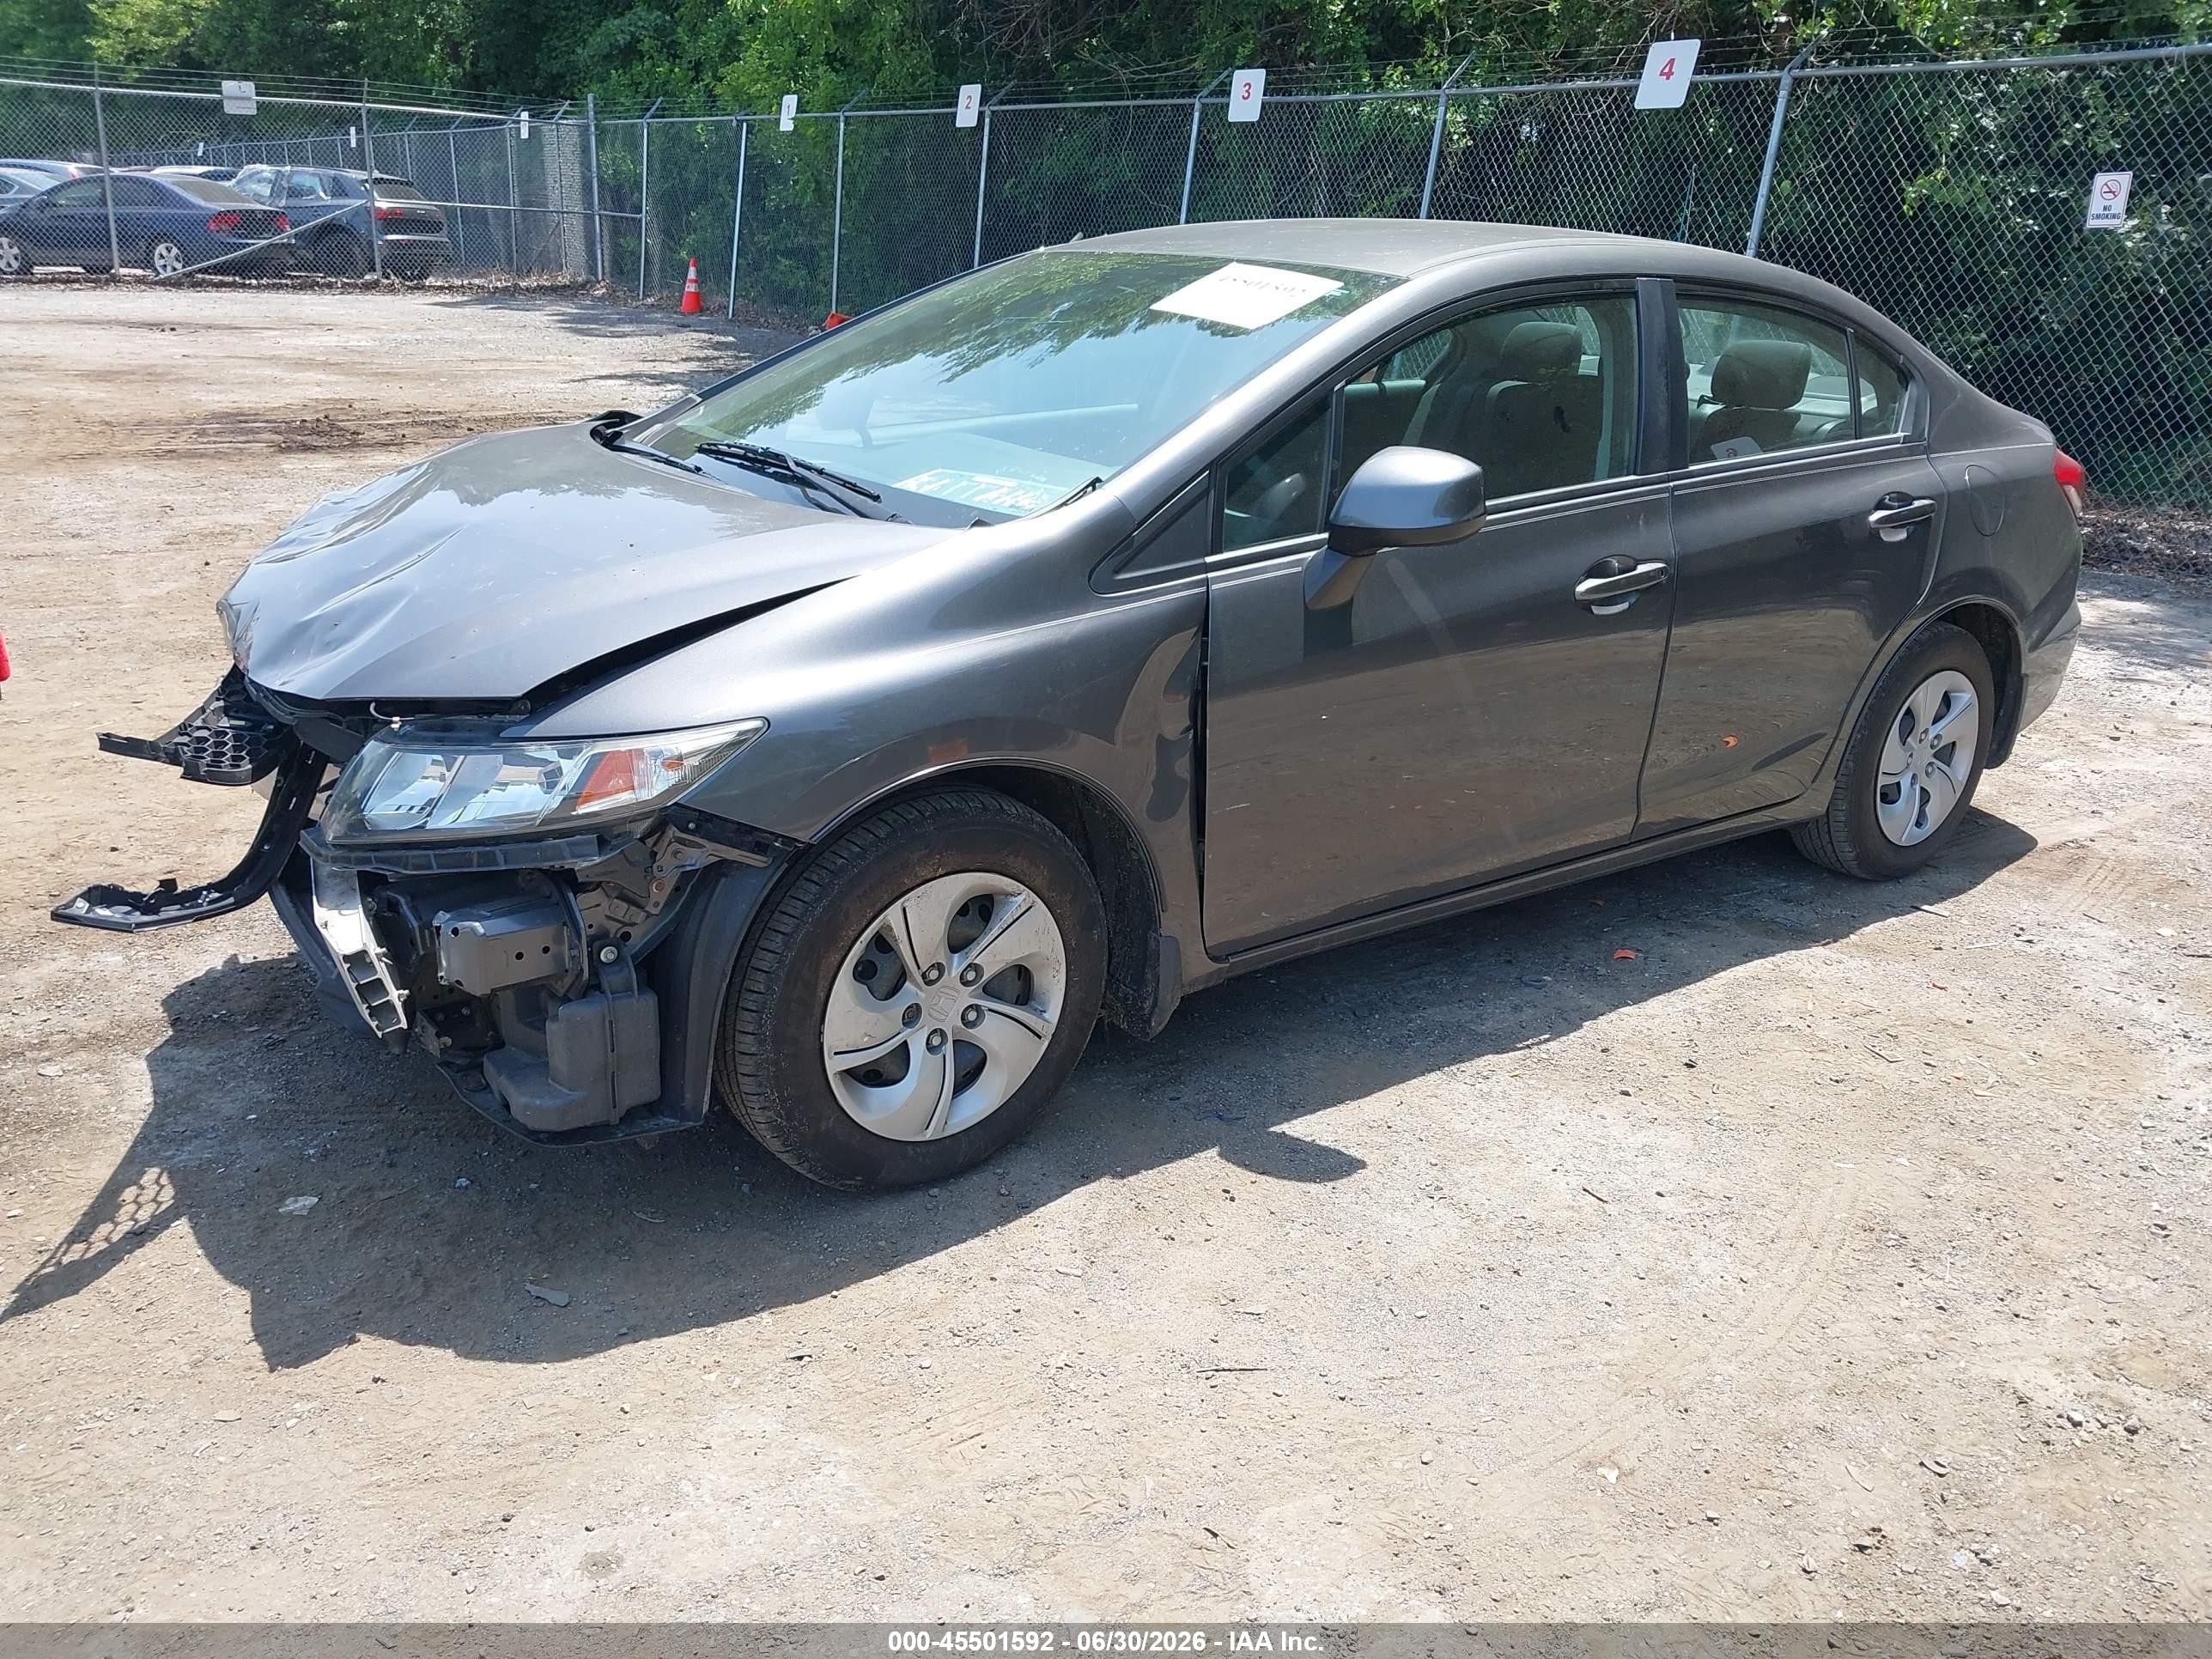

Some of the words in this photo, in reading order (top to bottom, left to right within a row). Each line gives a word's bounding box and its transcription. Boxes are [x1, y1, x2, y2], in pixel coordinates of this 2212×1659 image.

[1659, 58, 1675, 80] 4
[1241, 81, 1252, 101] 3
[964, 94, 972, 110] 2
[2091, 212, 2122, 221] SMOKING
